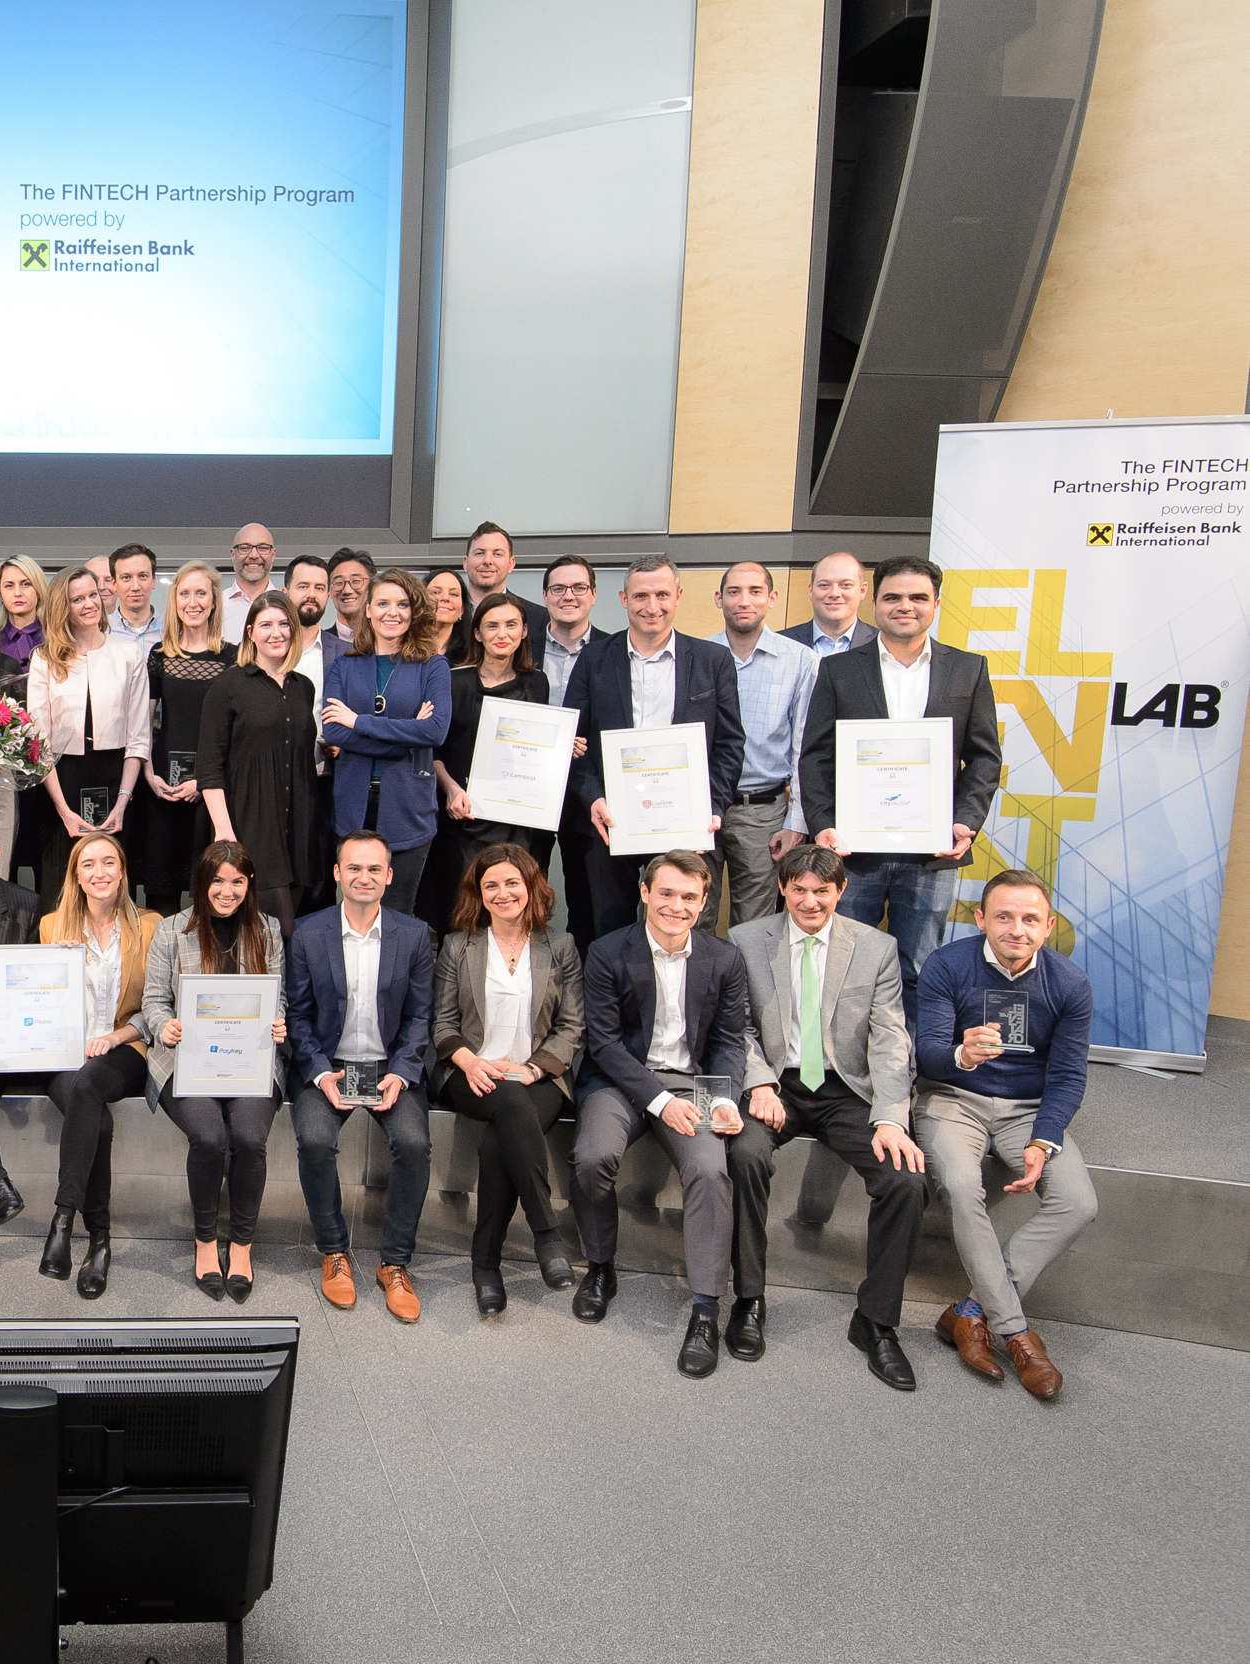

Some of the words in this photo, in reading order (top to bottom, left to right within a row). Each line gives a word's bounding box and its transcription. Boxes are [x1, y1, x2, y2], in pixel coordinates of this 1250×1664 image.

[20, 184, 55, 200] The
[62, 184, 148, 201] FINTECH
[156, 185, 266, 206] Partnership
[273, 185, 354, 207] Program
[20, 210, 97, 230] powered
[104, 210, 125, 231] by
[54, 238, 143, 255] Raiffeisen
[148, 239, 195, 256] Bank
[54, 257, 159, 272] International
[1121, 460, 1156, 474] The
[1162, 458, 1249, 473] FINTECH
[1053, 479, 1159, 495] Partnership
[1166, 478, 1247, 494] Program
[1161, 503, 1223, 517] powered
[1227, 502, 1244, 516] by
[1117, 521, 1196, 534] Raiffeisen
[1200, 521, 1242, 534] Bank
[1115, 534, 1210, 546] International
[511, 744, 538, 752] CERTIFICATE
[510, 772, 536, 781] cambrist
[219, 1047, 243, 1055] PayKey
